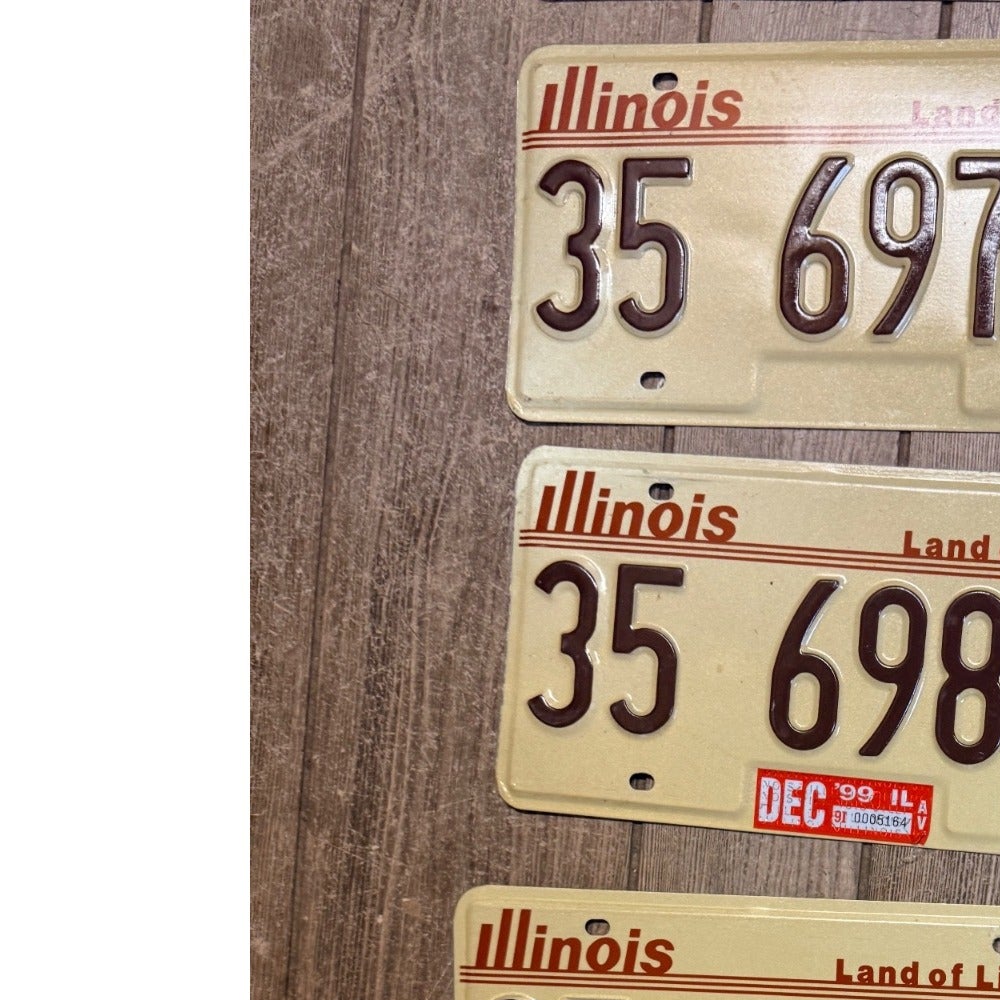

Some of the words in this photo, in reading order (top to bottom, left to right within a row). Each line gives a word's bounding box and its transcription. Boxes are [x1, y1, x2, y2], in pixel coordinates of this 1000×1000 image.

[538, 66, 743, 131] Illinois
[912, 98, 1000, 127] Land
[536, 157, 691, 333] 35
[535, 470, 738, 543] Illinois
[903, 531, 990, 561] Land
[527, 560, 684, 735] 35
[758, 777, 827, 828] DEC
[890, 788, 914, 808] IL
[475, 908, 675, 975] Illinois
[836, 959, 919, 987] Land
[929, 963, 964, 988] of
